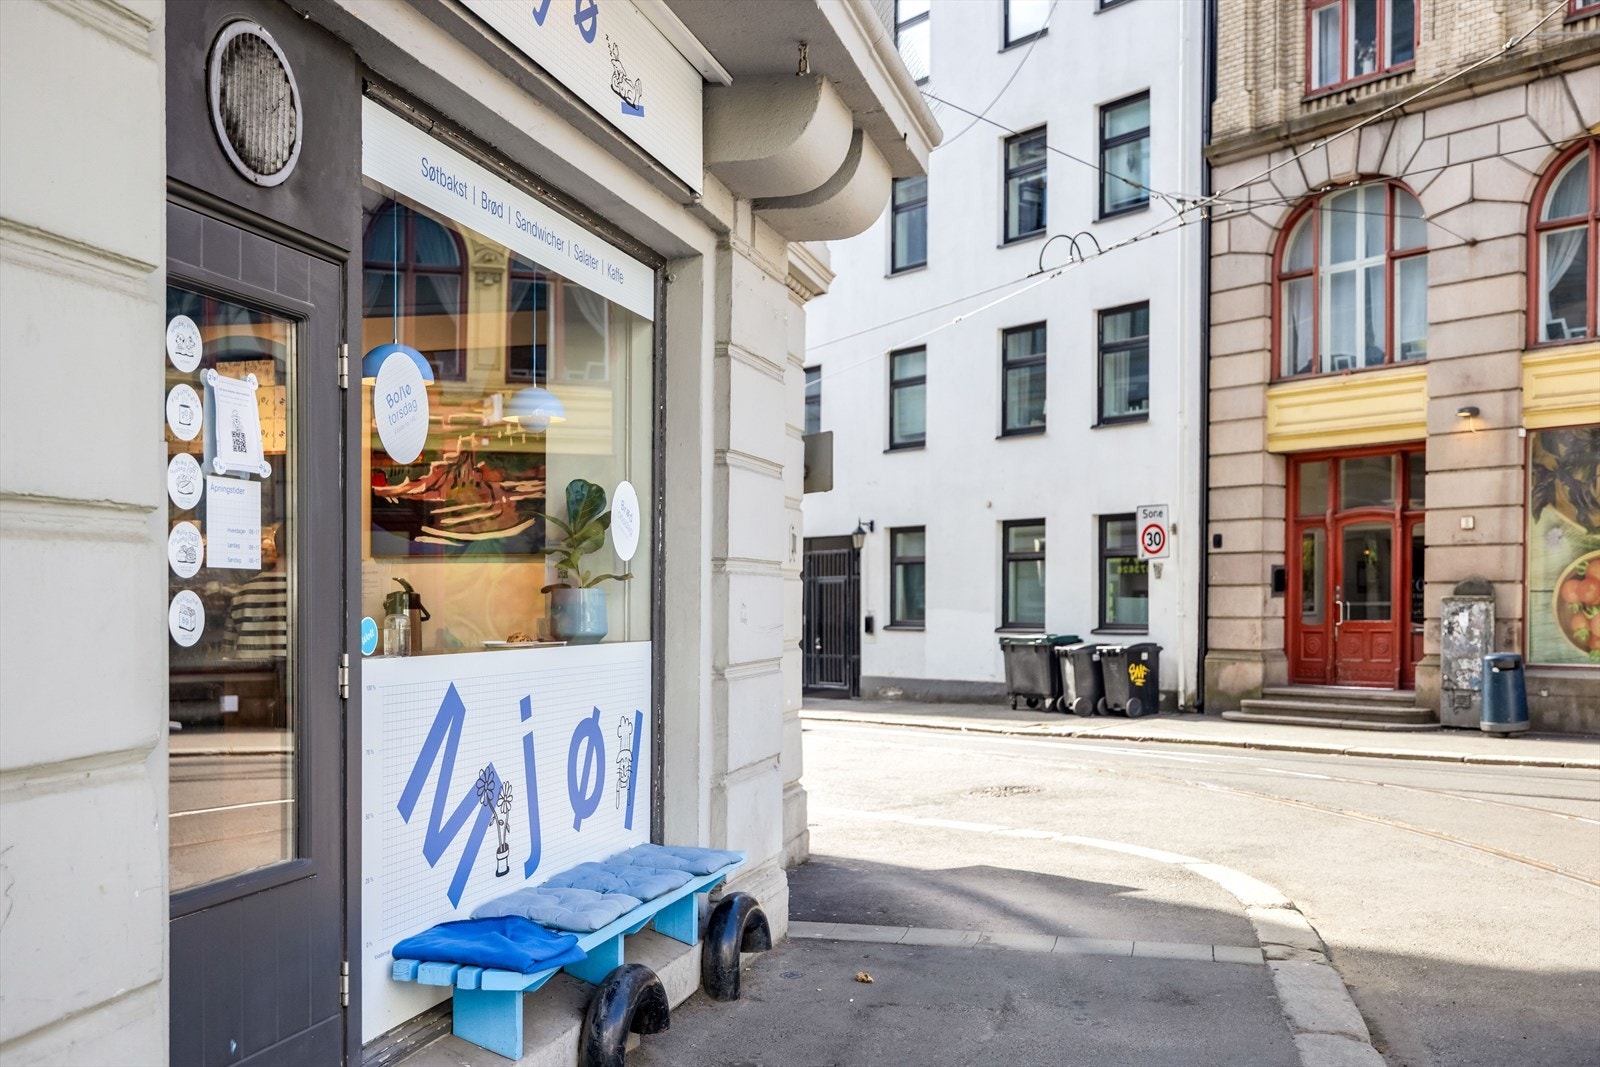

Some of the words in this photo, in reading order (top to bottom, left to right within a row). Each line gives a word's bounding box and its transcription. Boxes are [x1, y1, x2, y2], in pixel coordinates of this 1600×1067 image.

[421, 157, 468, 200] Søtbakst
[481, 191, 504, 219] Brød
[515, 211, 565, 252] Sandwicher
[574, 244, 599, 271] Salater
[607, 263, 625, 285] Kaffe
[388, 399, 418, 426] torsdag
[210, 482, 246, 495] Åpningstider
[1142, 508, 1164, 519] Sone
[1146, 531, 1162, 547] 30
[396, 681, 644, 910] Mjøl
